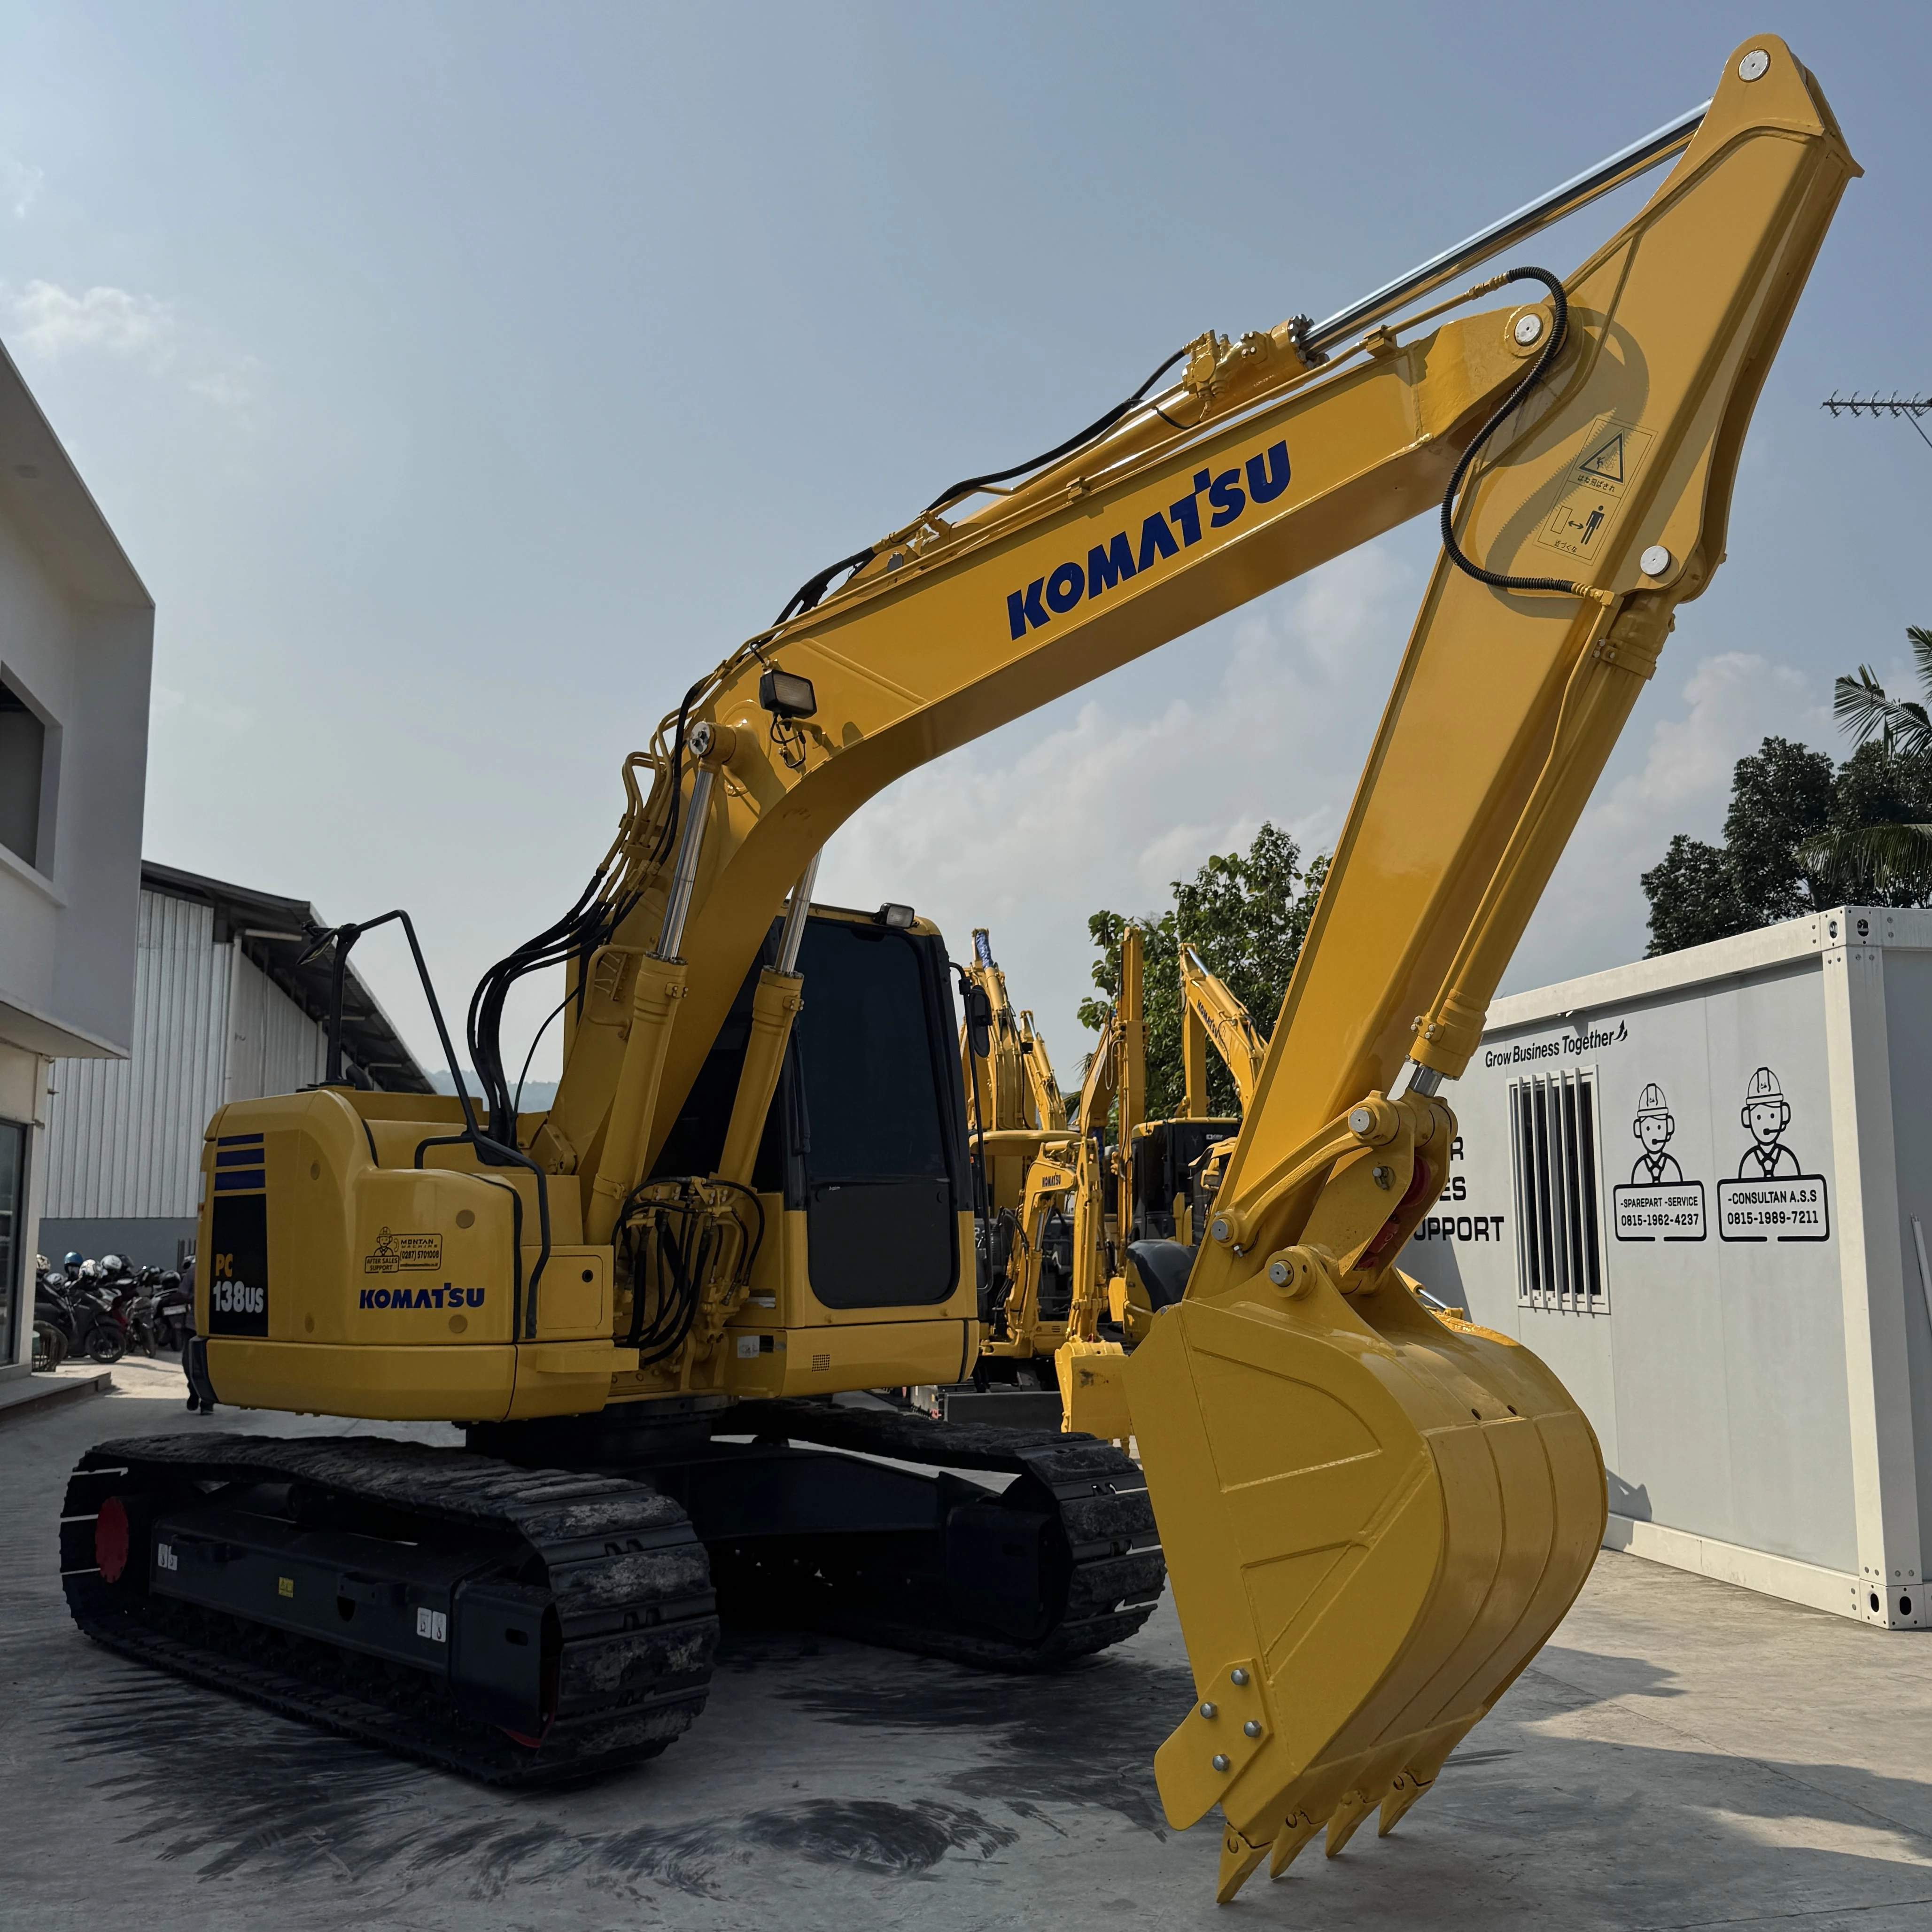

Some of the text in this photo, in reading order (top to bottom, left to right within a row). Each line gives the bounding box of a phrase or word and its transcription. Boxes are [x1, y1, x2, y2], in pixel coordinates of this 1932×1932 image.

[1007, 439, 1291, 641] KOMATSU
[1485, 1029, 1614, 1068] Grow Business Together
[1621, 1196, 1698, 1208] -SPAREPART -SERVICE
[1728, 1189, 1817, 1205] -CONSULTAN A.S.S
[1413, 1216, 1504, 1241] UPPORT
[1621, 1213, 1699, 1226] 0815-1962-4237
[1727, 1210, 1818, 1225] 0815-1989-7211
[215, 1253, 233, 1277] PC
[400, 1250, 439, 1261] (0287) 5701008
[213, 1281, 264, 1313] 138US
[359, 1282, 485, 1309] KOMATSU
